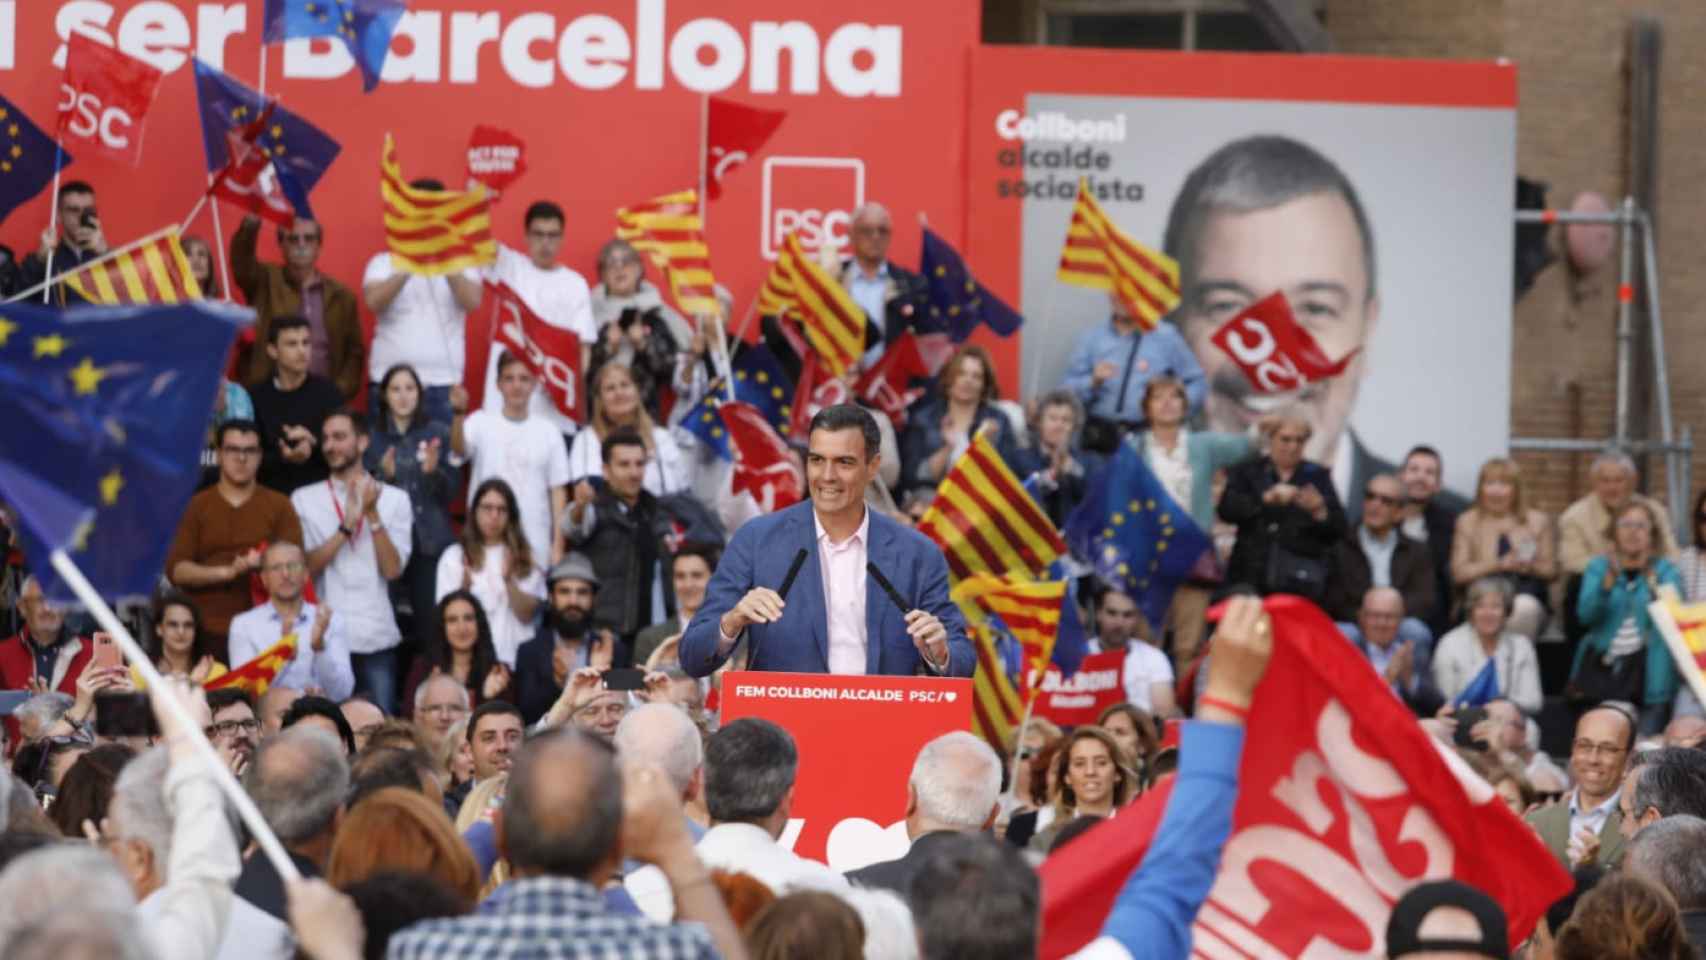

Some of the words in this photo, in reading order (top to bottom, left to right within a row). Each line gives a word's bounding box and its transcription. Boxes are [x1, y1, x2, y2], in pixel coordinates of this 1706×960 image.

[52, 0, 247, 75] ser
[995, 110, 1127, 142] Collboni
[997, 145, 1111, 170] alcalde
[997, 175, 1145, 201] sociaista
[775, 208, 849, 248] PSC
[736, 685, 766, 698] FEM
[768, 686, 837, 699] COLLBONI
[839, 688, 904, 702] ALCALDE
